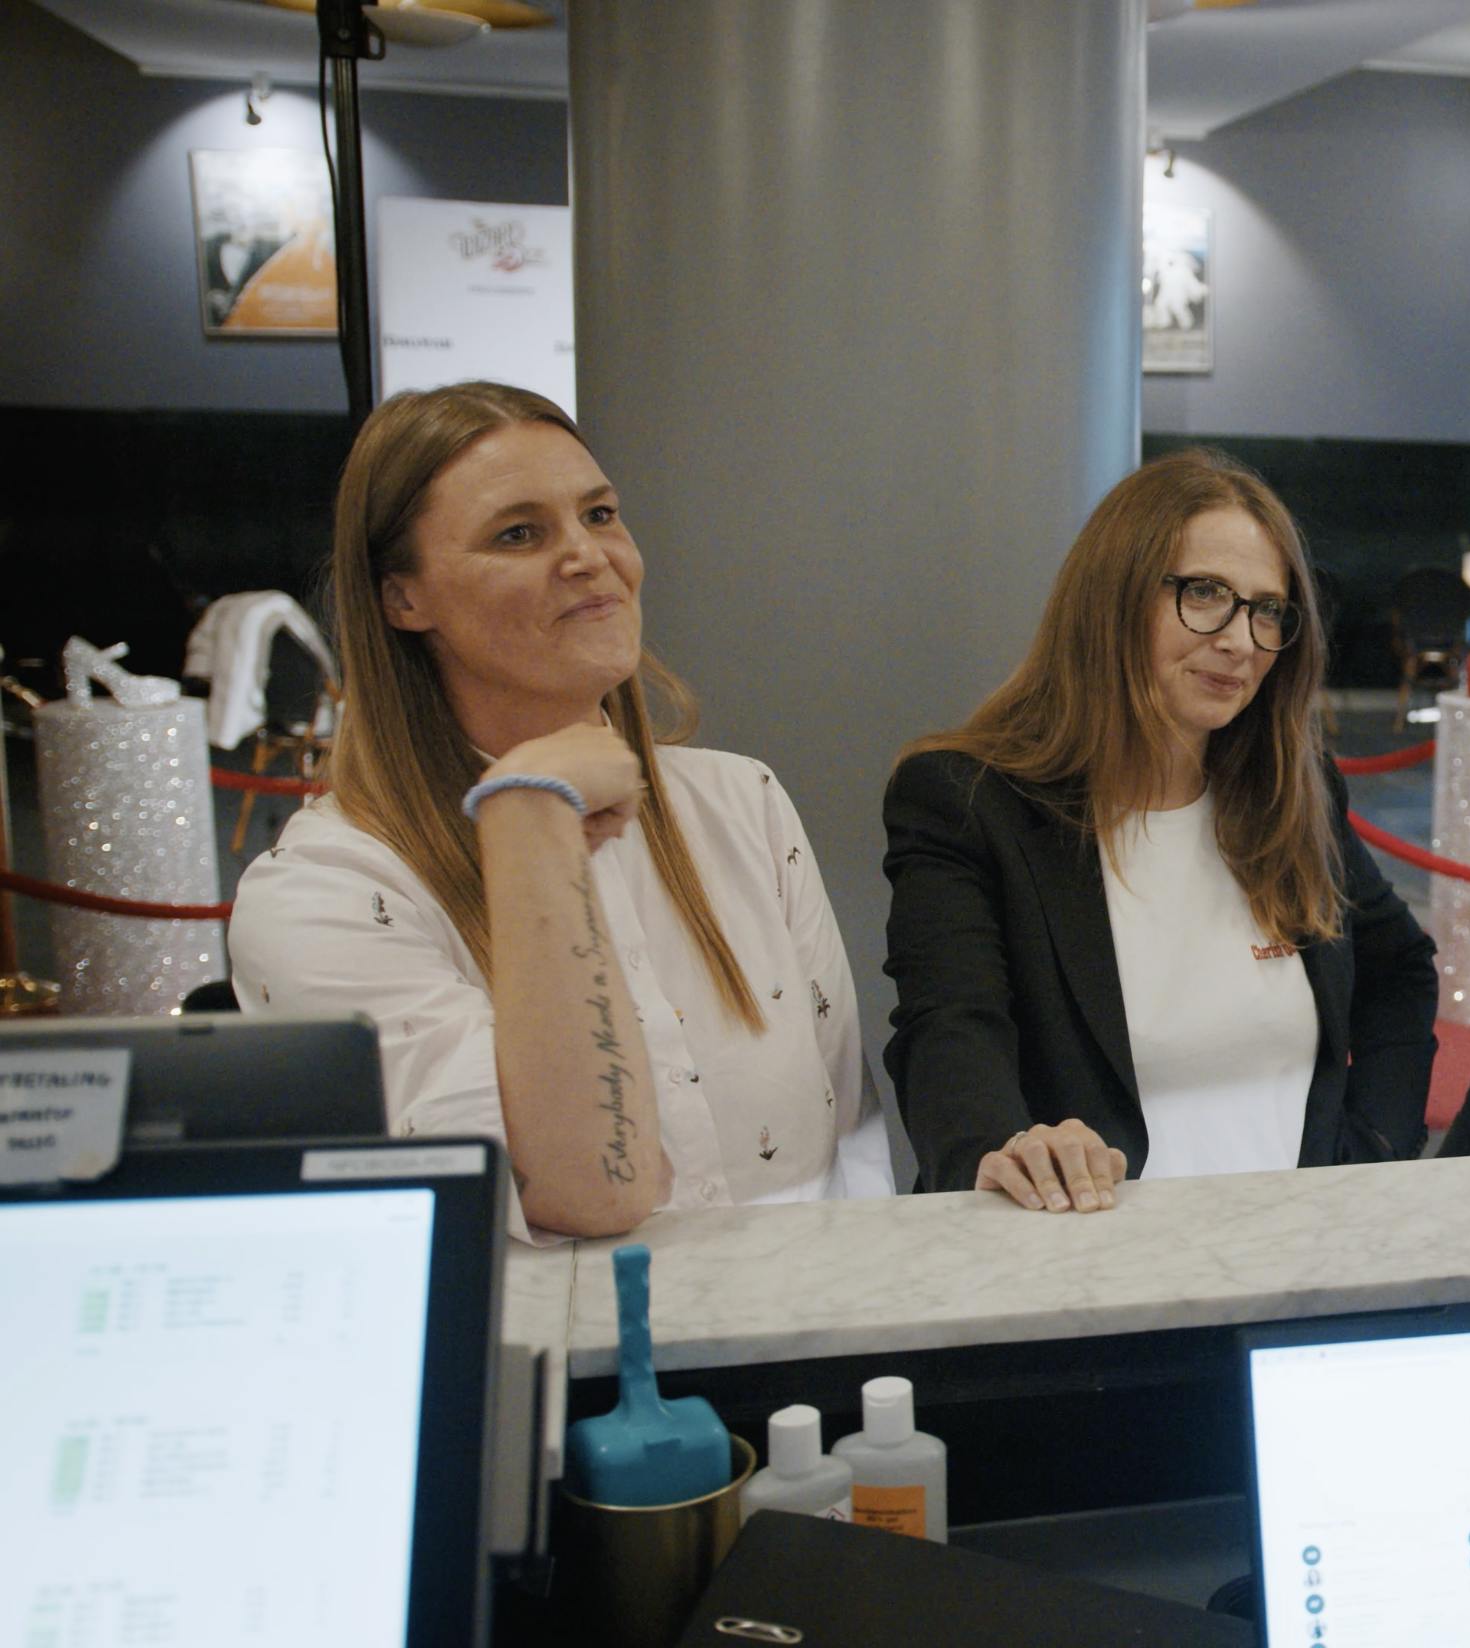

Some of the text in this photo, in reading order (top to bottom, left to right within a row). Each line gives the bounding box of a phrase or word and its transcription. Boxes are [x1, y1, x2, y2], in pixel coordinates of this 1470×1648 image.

[593, 972, 608, 987] a
[584, 995, 627, 1060] Needs
[597, 1061, 638, 1186] Everybody
